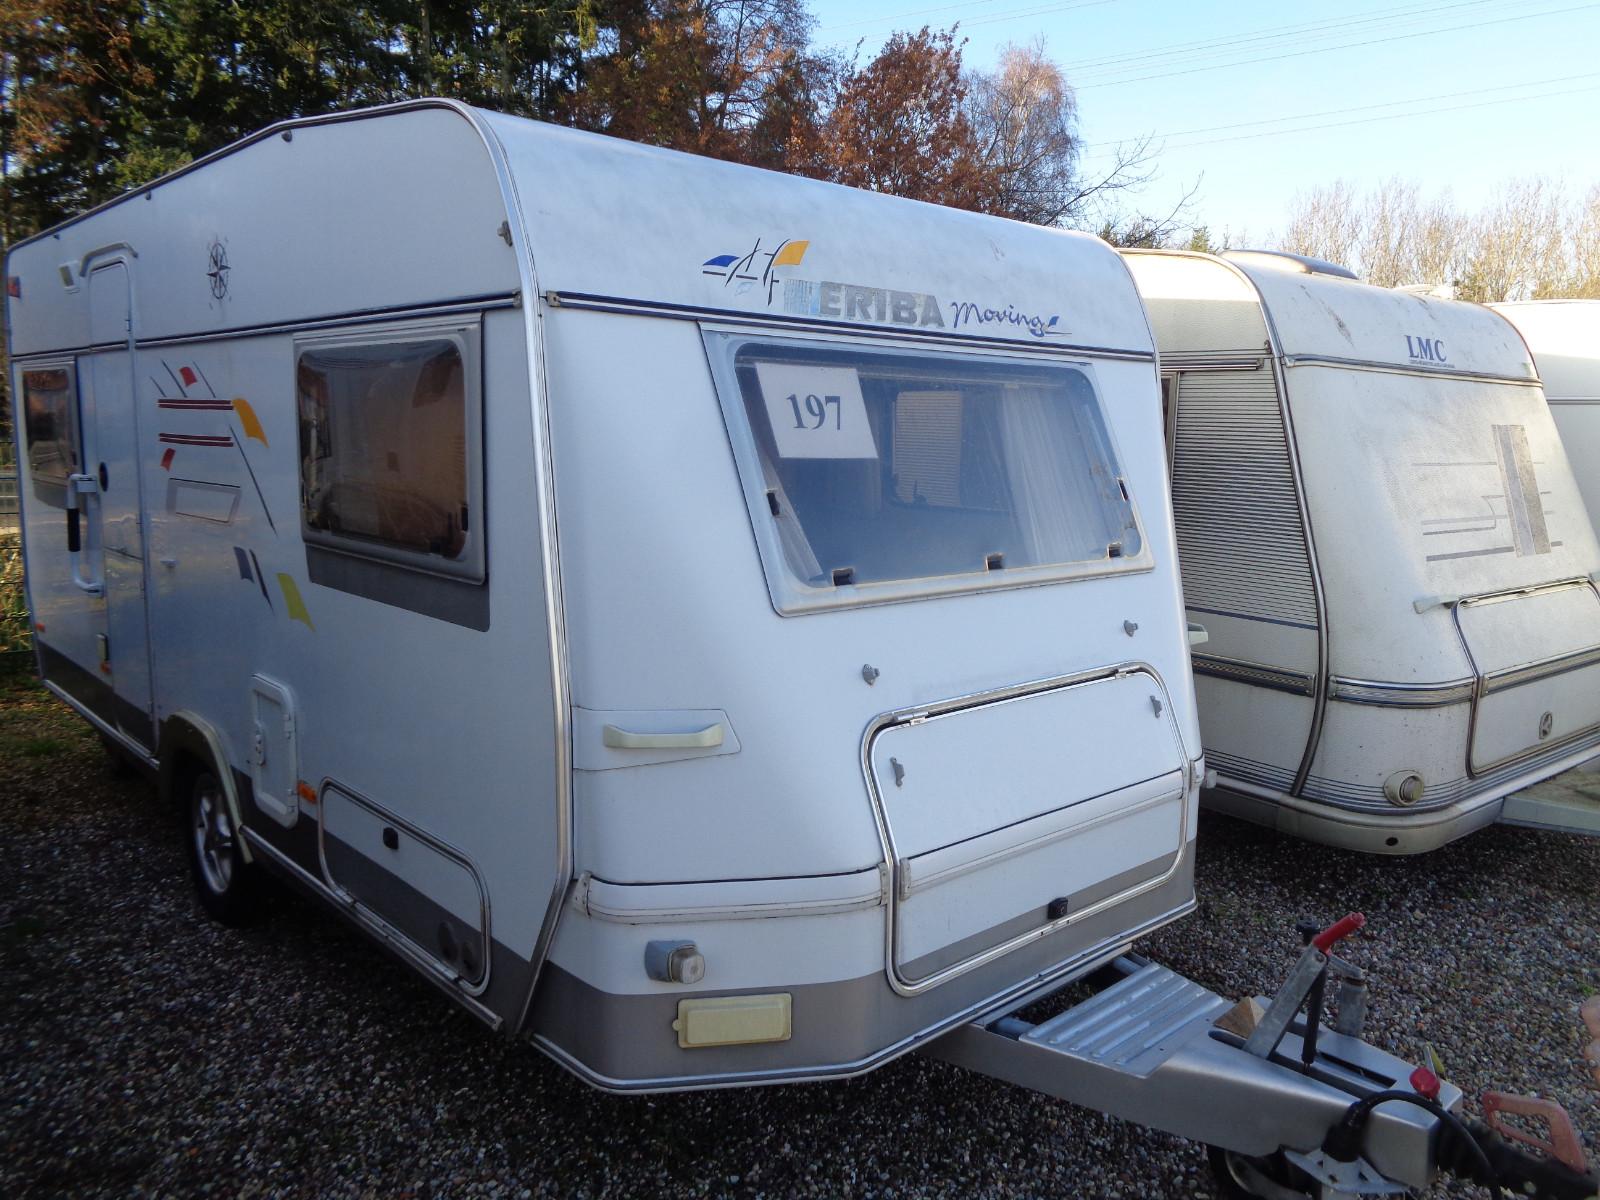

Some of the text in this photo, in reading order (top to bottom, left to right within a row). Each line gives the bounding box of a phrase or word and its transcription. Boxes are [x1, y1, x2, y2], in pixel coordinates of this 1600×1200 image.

[820, 281, 1044, 337] ERIBA Moving
[1404, 335, 1447, 362] LMC
[786, 394, 841, 430] 197
